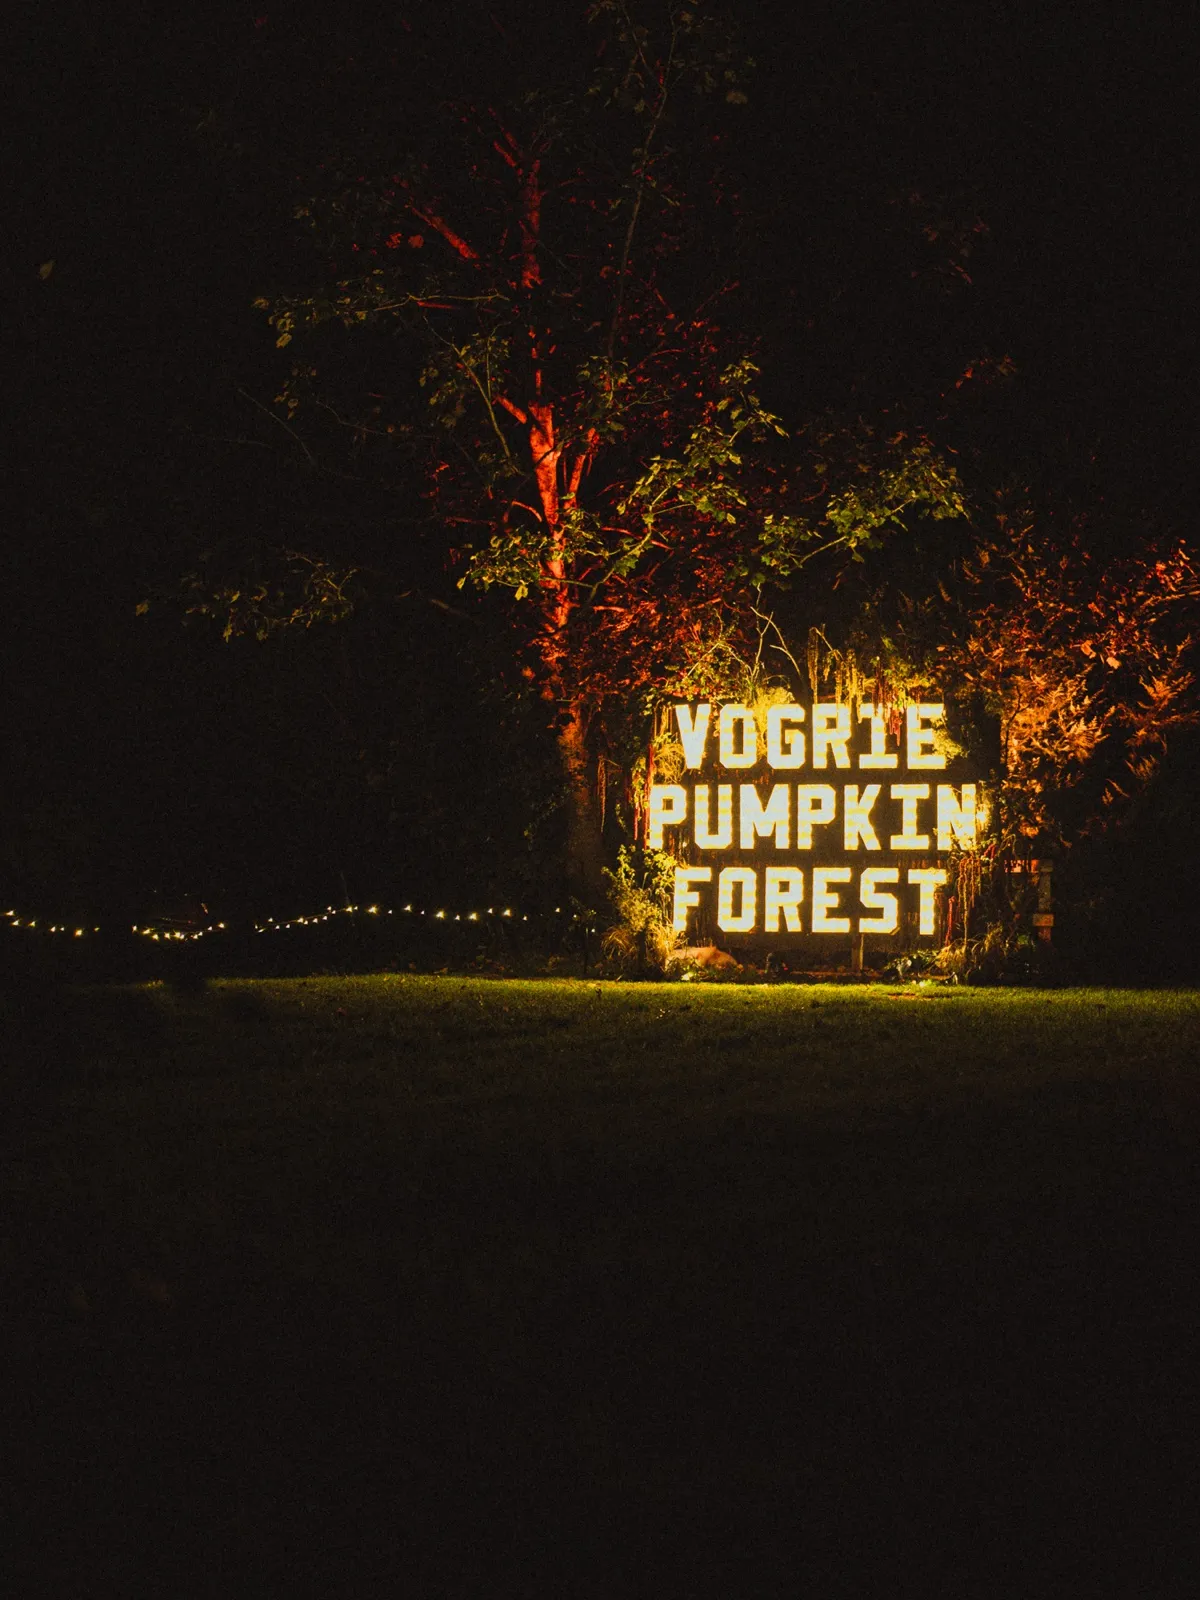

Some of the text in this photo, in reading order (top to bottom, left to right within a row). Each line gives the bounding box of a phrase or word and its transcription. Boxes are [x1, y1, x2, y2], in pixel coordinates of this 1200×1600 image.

[675, 703, 946, 770] VOGRIE
[649, 783, 977, 851] PUMPKIN
[673, 866, 947, 935] FOREST
